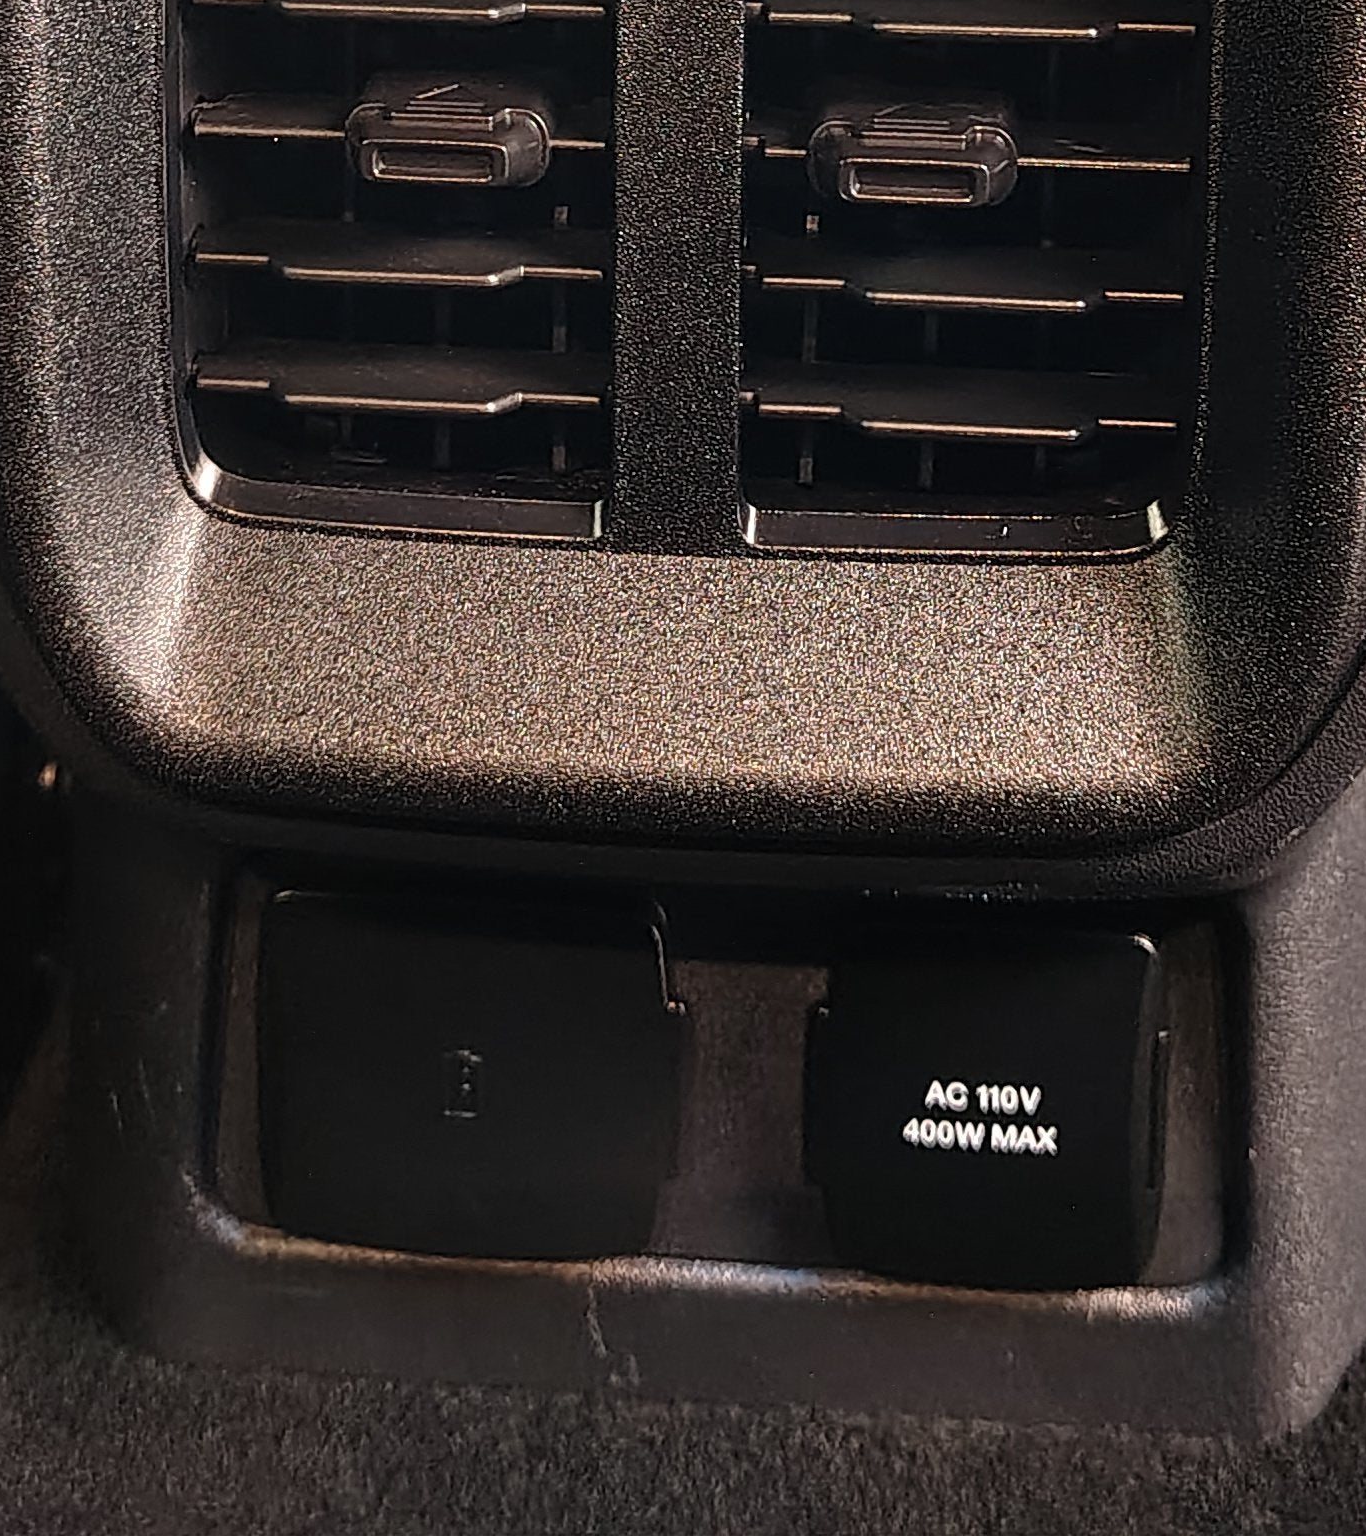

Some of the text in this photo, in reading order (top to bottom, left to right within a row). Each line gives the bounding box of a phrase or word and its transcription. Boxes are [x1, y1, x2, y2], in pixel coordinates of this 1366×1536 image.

[924, 1079, 1042, 1115] AC 110V
[902, 1117, 1058, 1156] 400W MAX
